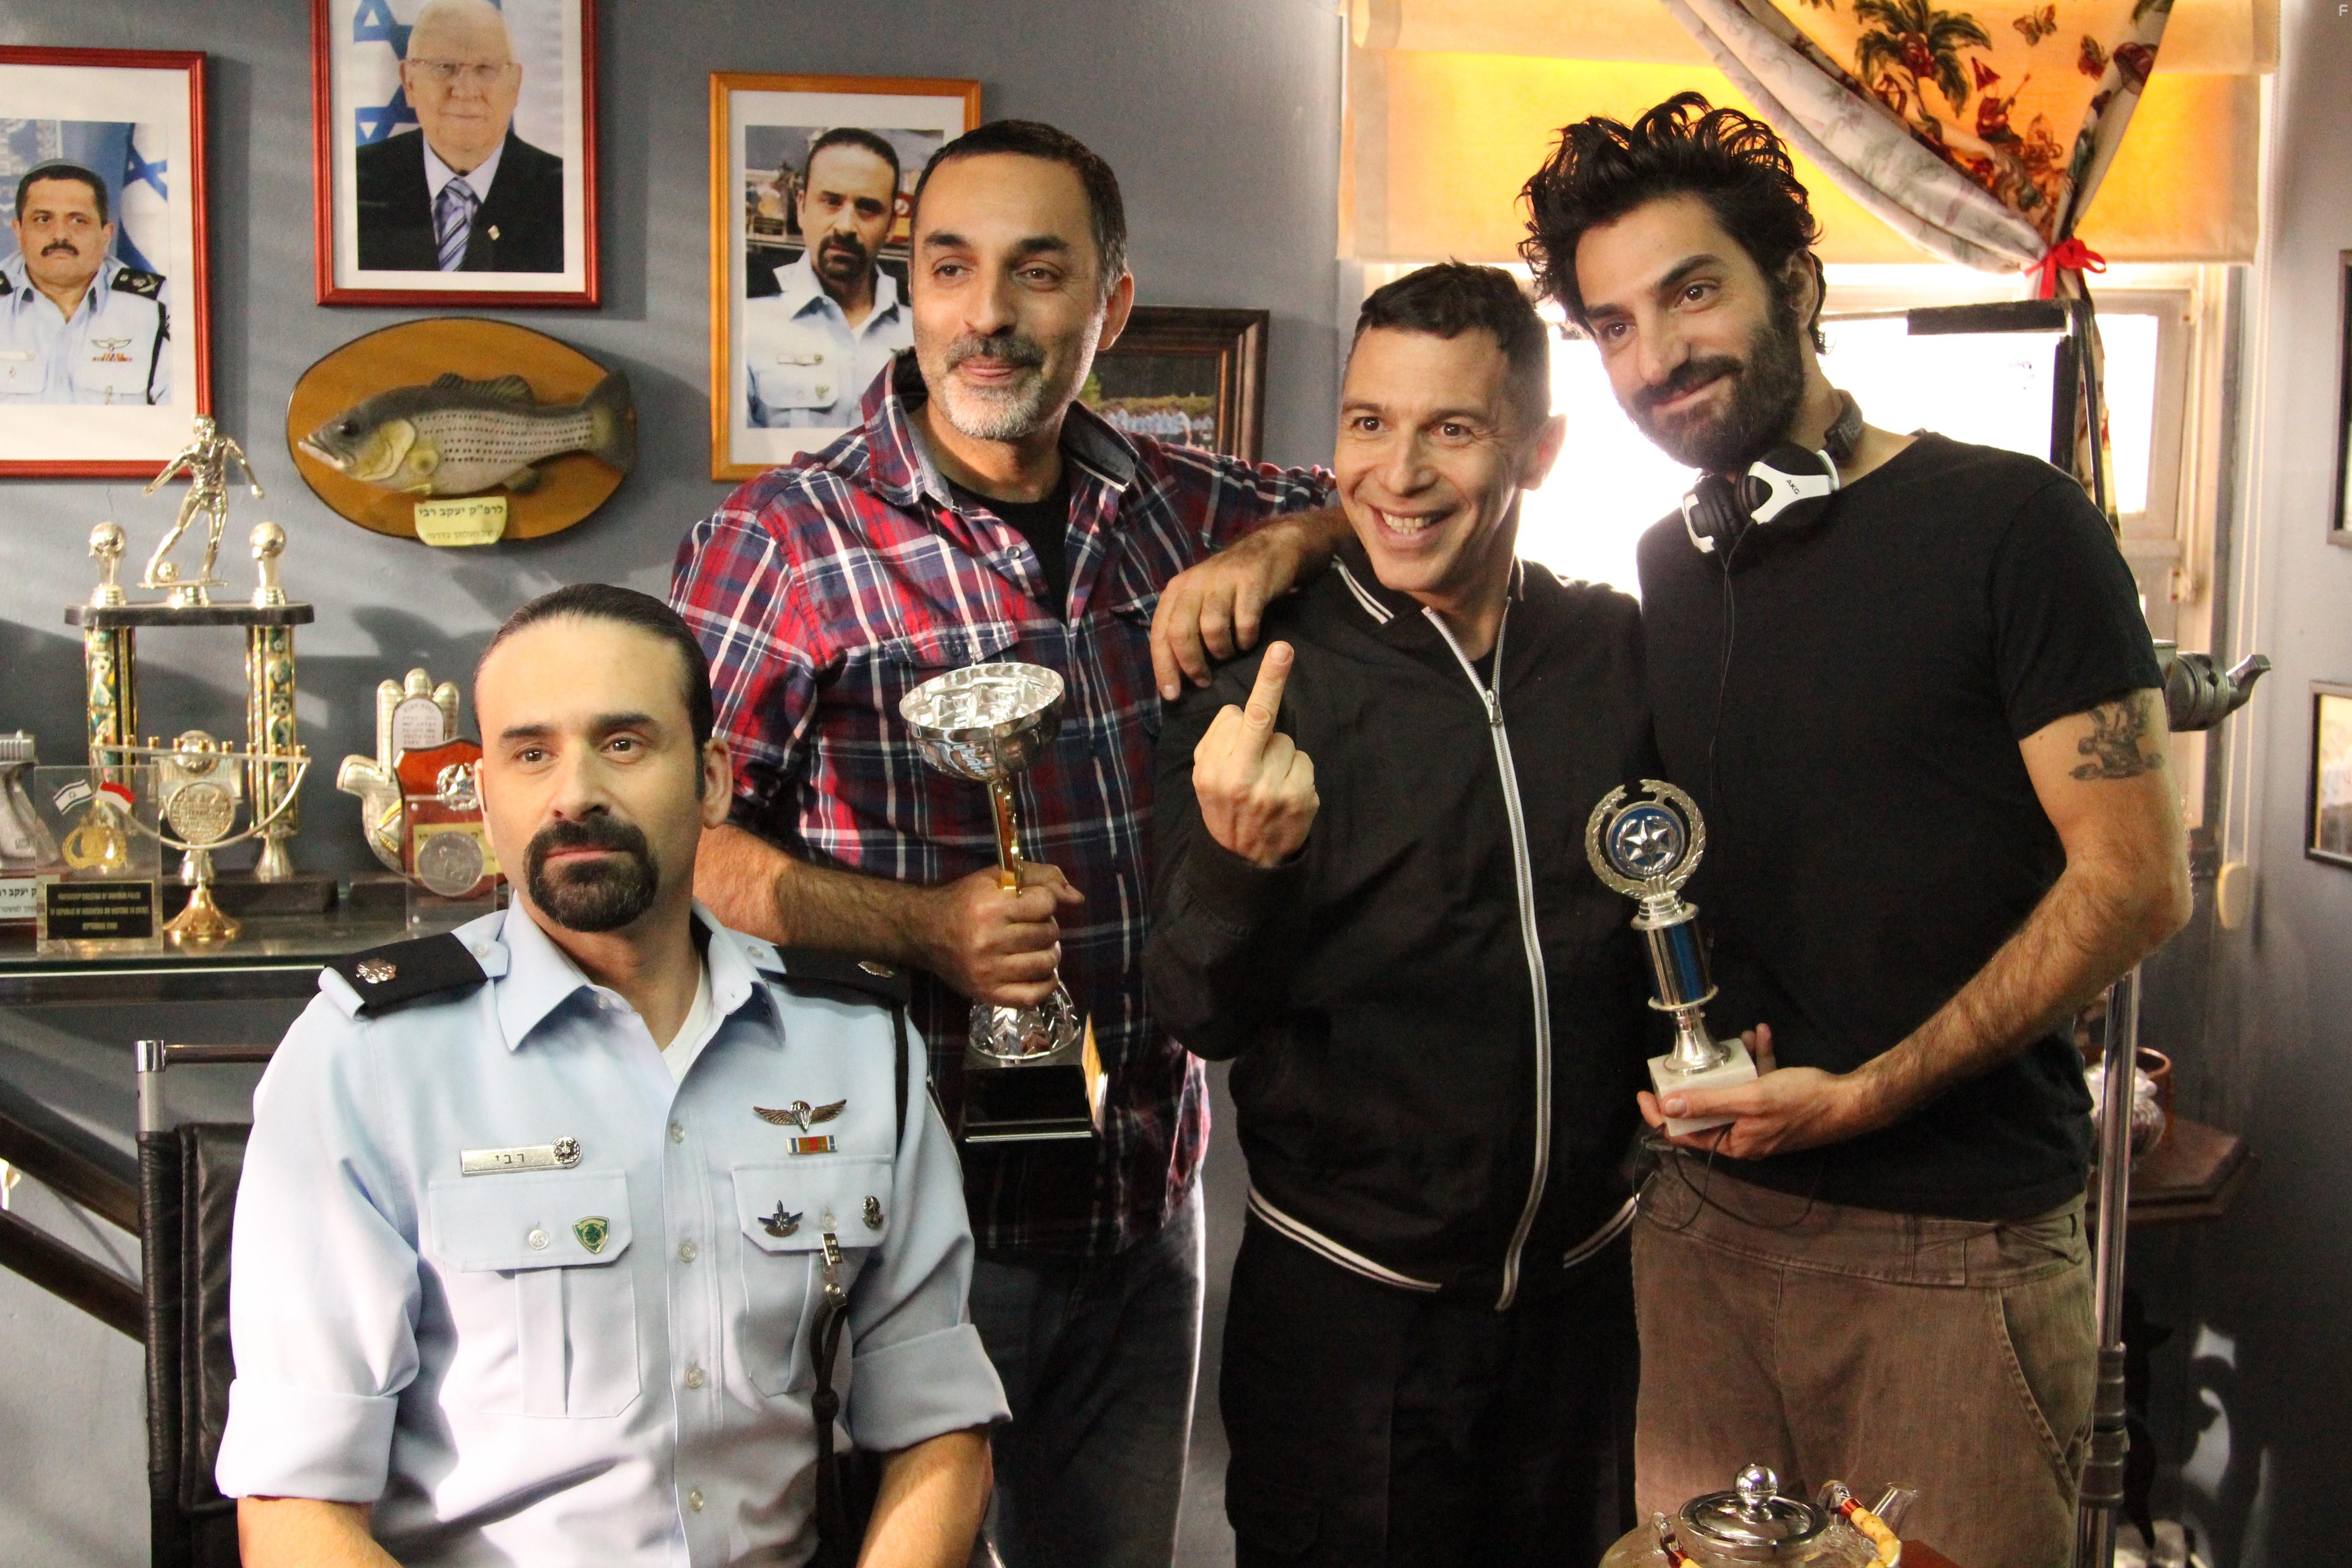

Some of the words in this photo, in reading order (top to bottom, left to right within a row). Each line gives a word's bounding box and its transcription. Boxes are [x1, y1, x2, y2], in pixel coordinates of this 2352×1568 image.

[1786, 479, 1800, 495] AKG
[418, 507, 436, 517] רבי
[439, 506, 465, 517] יעקב
[0, 888, 6, 897] ר
[9, 887, 29, 898] יעקב
[495, 1153, 524, 1164] רבי
